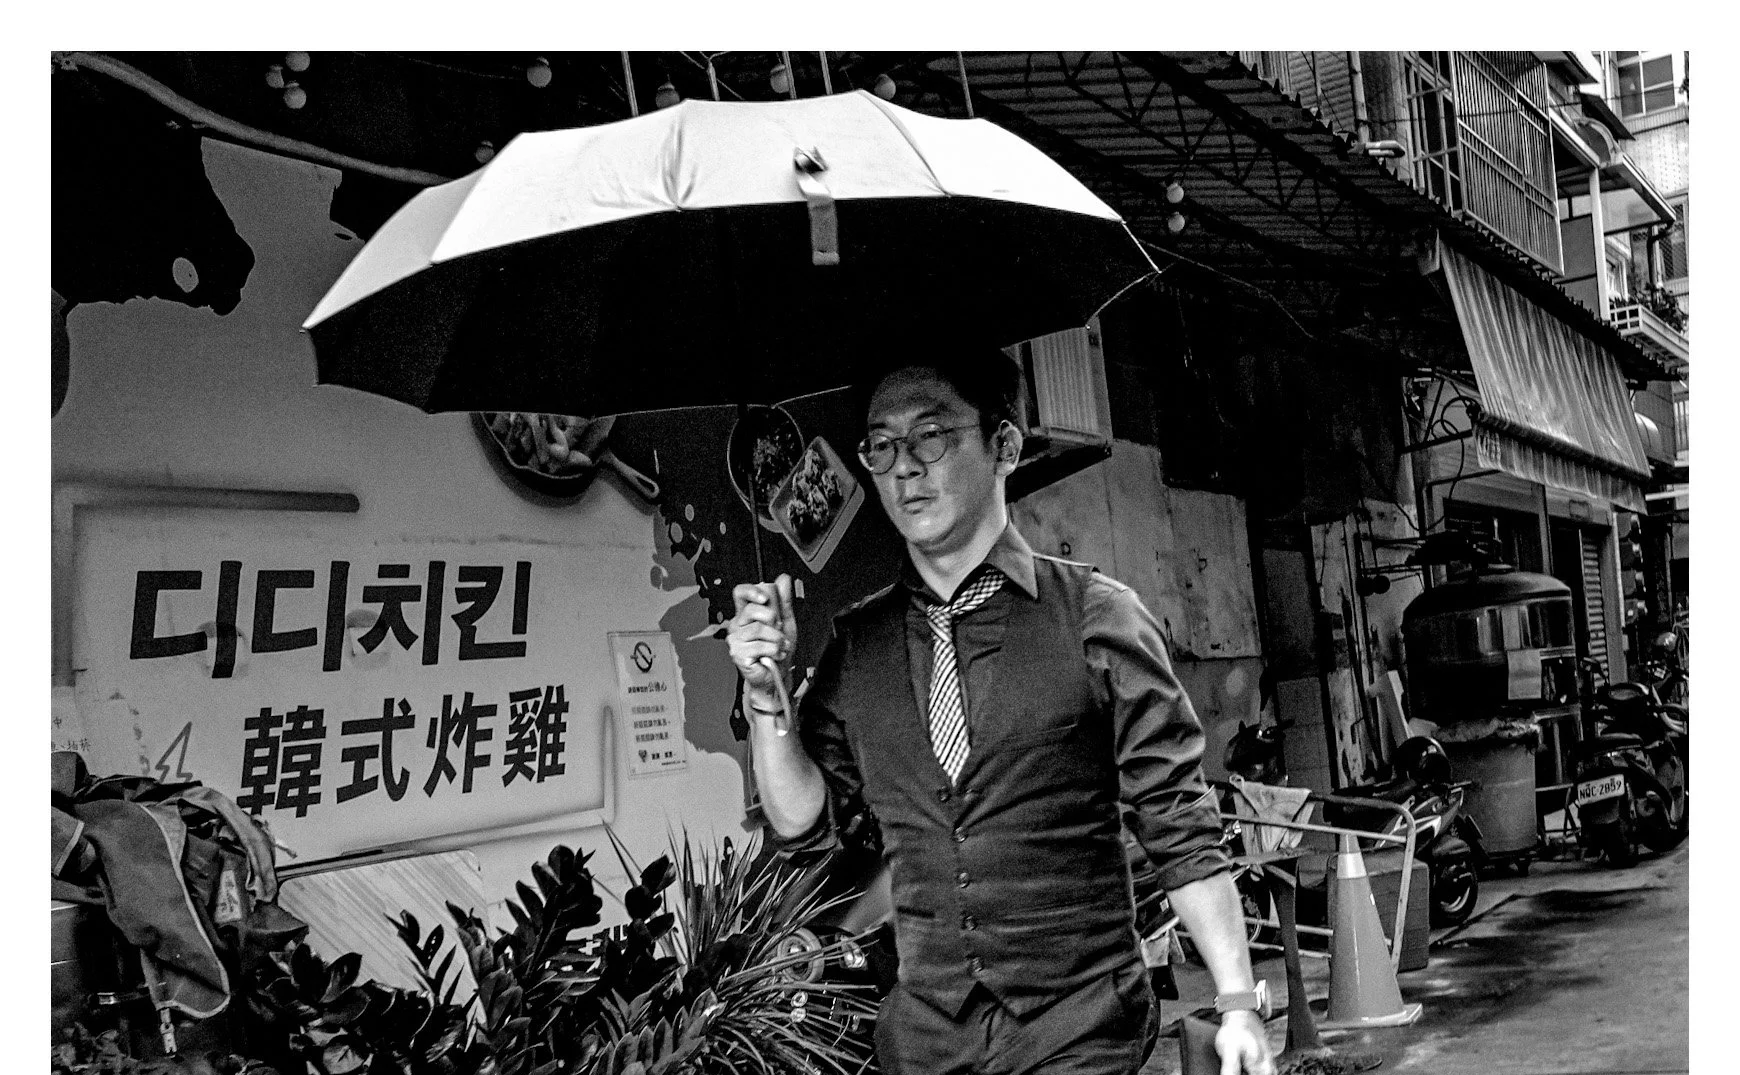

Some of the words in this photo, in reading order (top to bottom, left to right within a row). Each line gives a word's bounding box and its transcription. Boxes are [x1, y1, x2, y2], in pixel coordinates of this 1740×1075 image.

[129, 559, 532, 679] 디디치킨
[236, 684, 571, 818] 韓式炸雞
